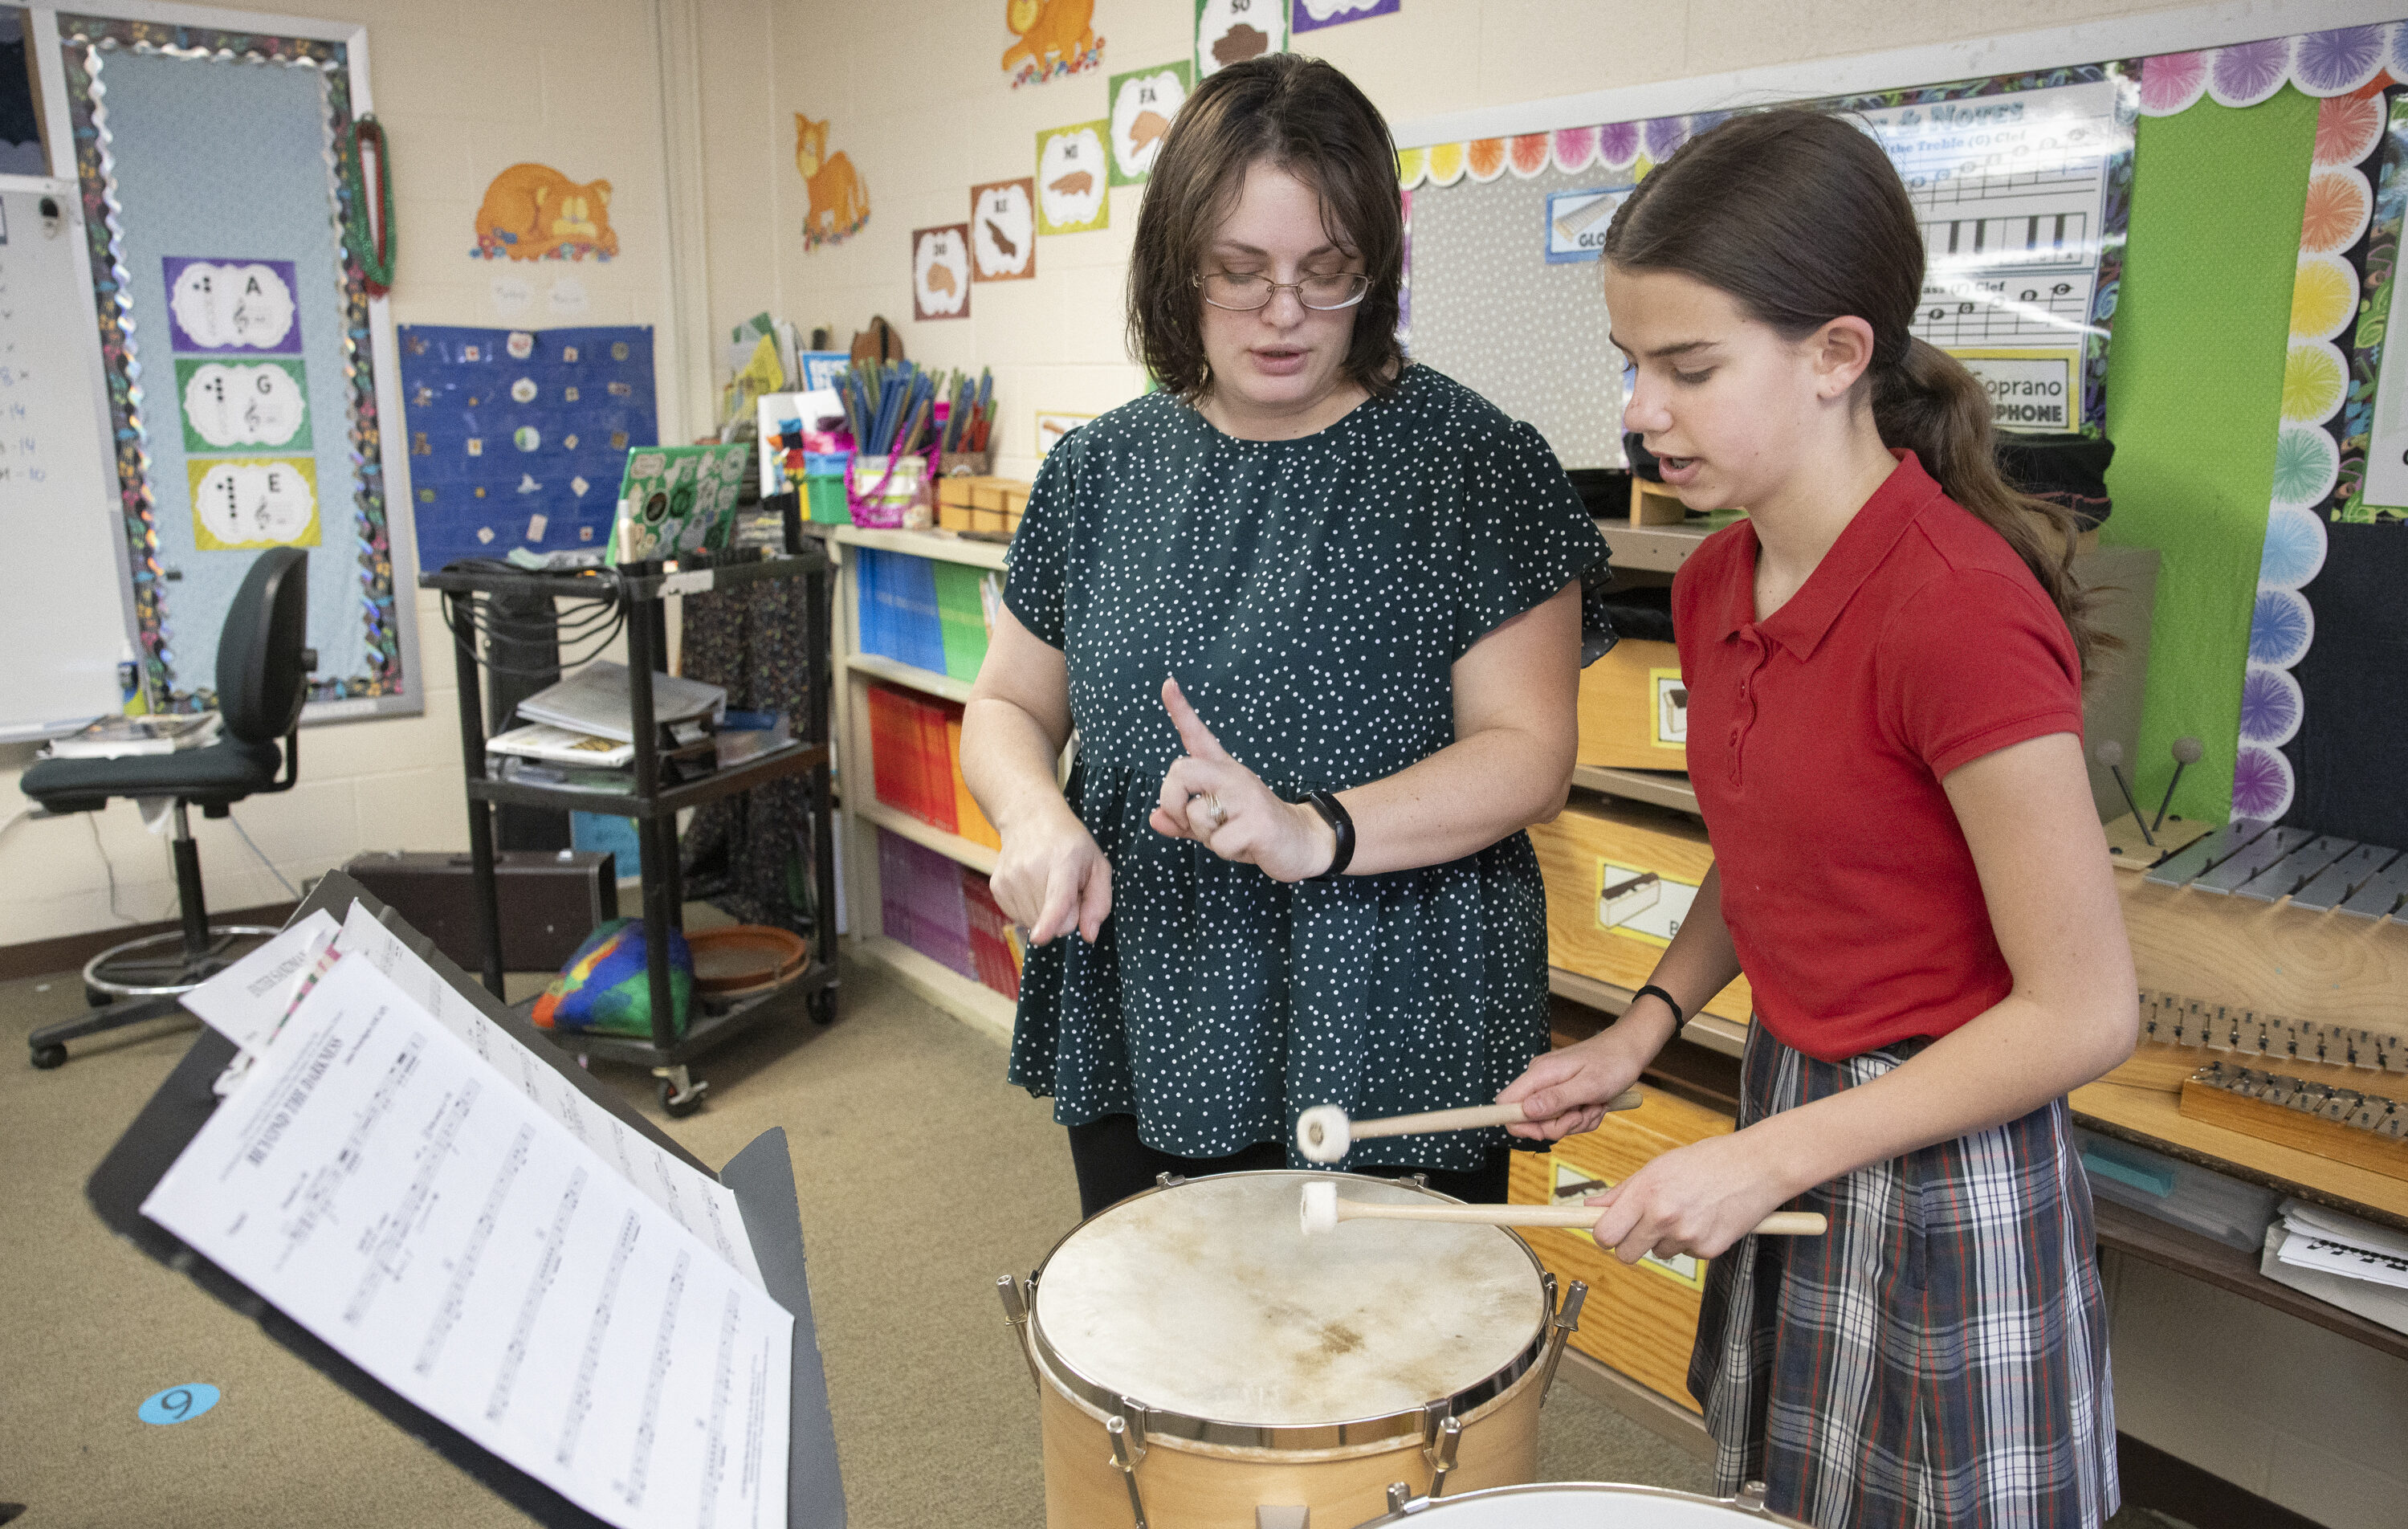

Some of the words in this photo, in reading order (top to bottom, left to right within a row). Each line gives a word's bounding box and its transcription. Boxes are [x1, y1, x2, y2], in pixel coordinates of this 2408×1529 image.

[1139, 88, 1157, 104] FA
[1917, 137, 1964, 152] Treble
[245, 276, 263, 295] A
[257, 375, 271, 394] G
[1975, 373, 2062, 400] oprano
[268, 473, 281, 492] E
[161, 1389, 193, 1419] 9
